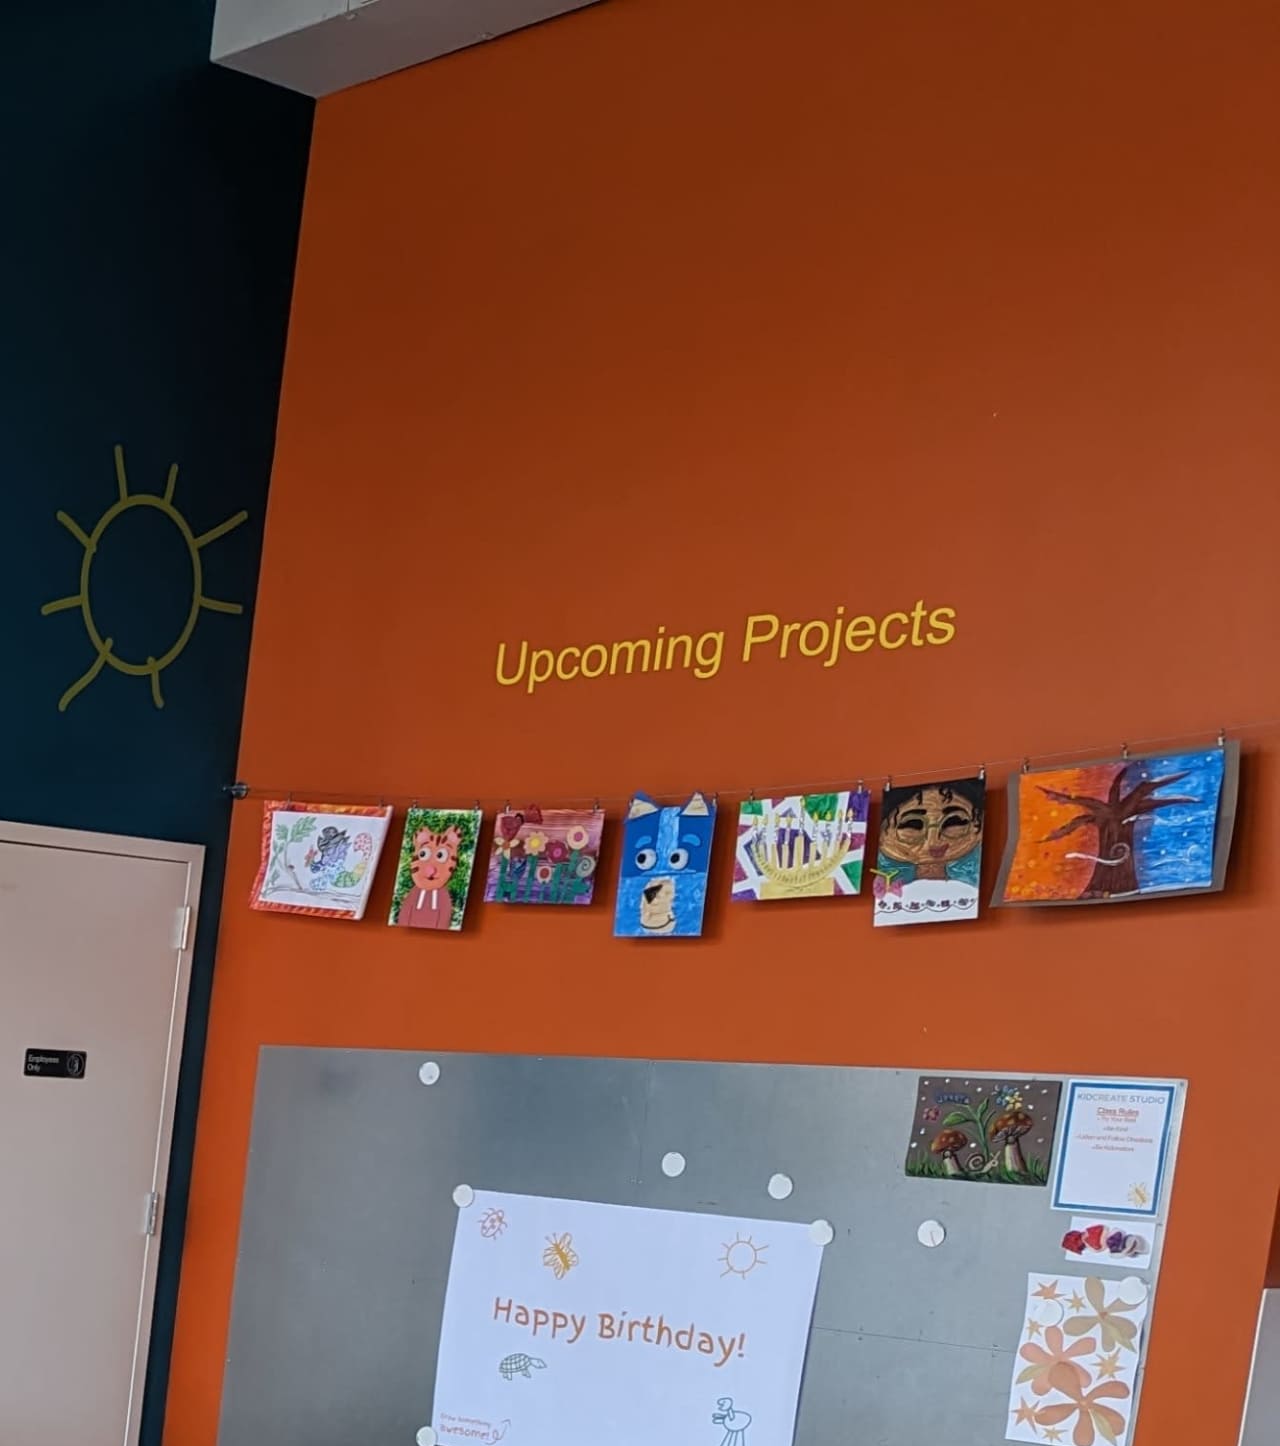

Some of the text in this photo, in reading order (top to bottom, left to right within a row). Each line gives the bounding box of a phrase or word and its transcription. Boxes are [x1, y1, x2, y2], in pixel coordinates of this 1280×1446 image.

[495, 599, 957, 694] Upcoming Projects
[1077, 1093, 1166, 1104] KIDCREATE STUDIO
[1097, 1106, 1117, 1115] Class
[492, 1296, 747, 1368] Happy Birthday!
